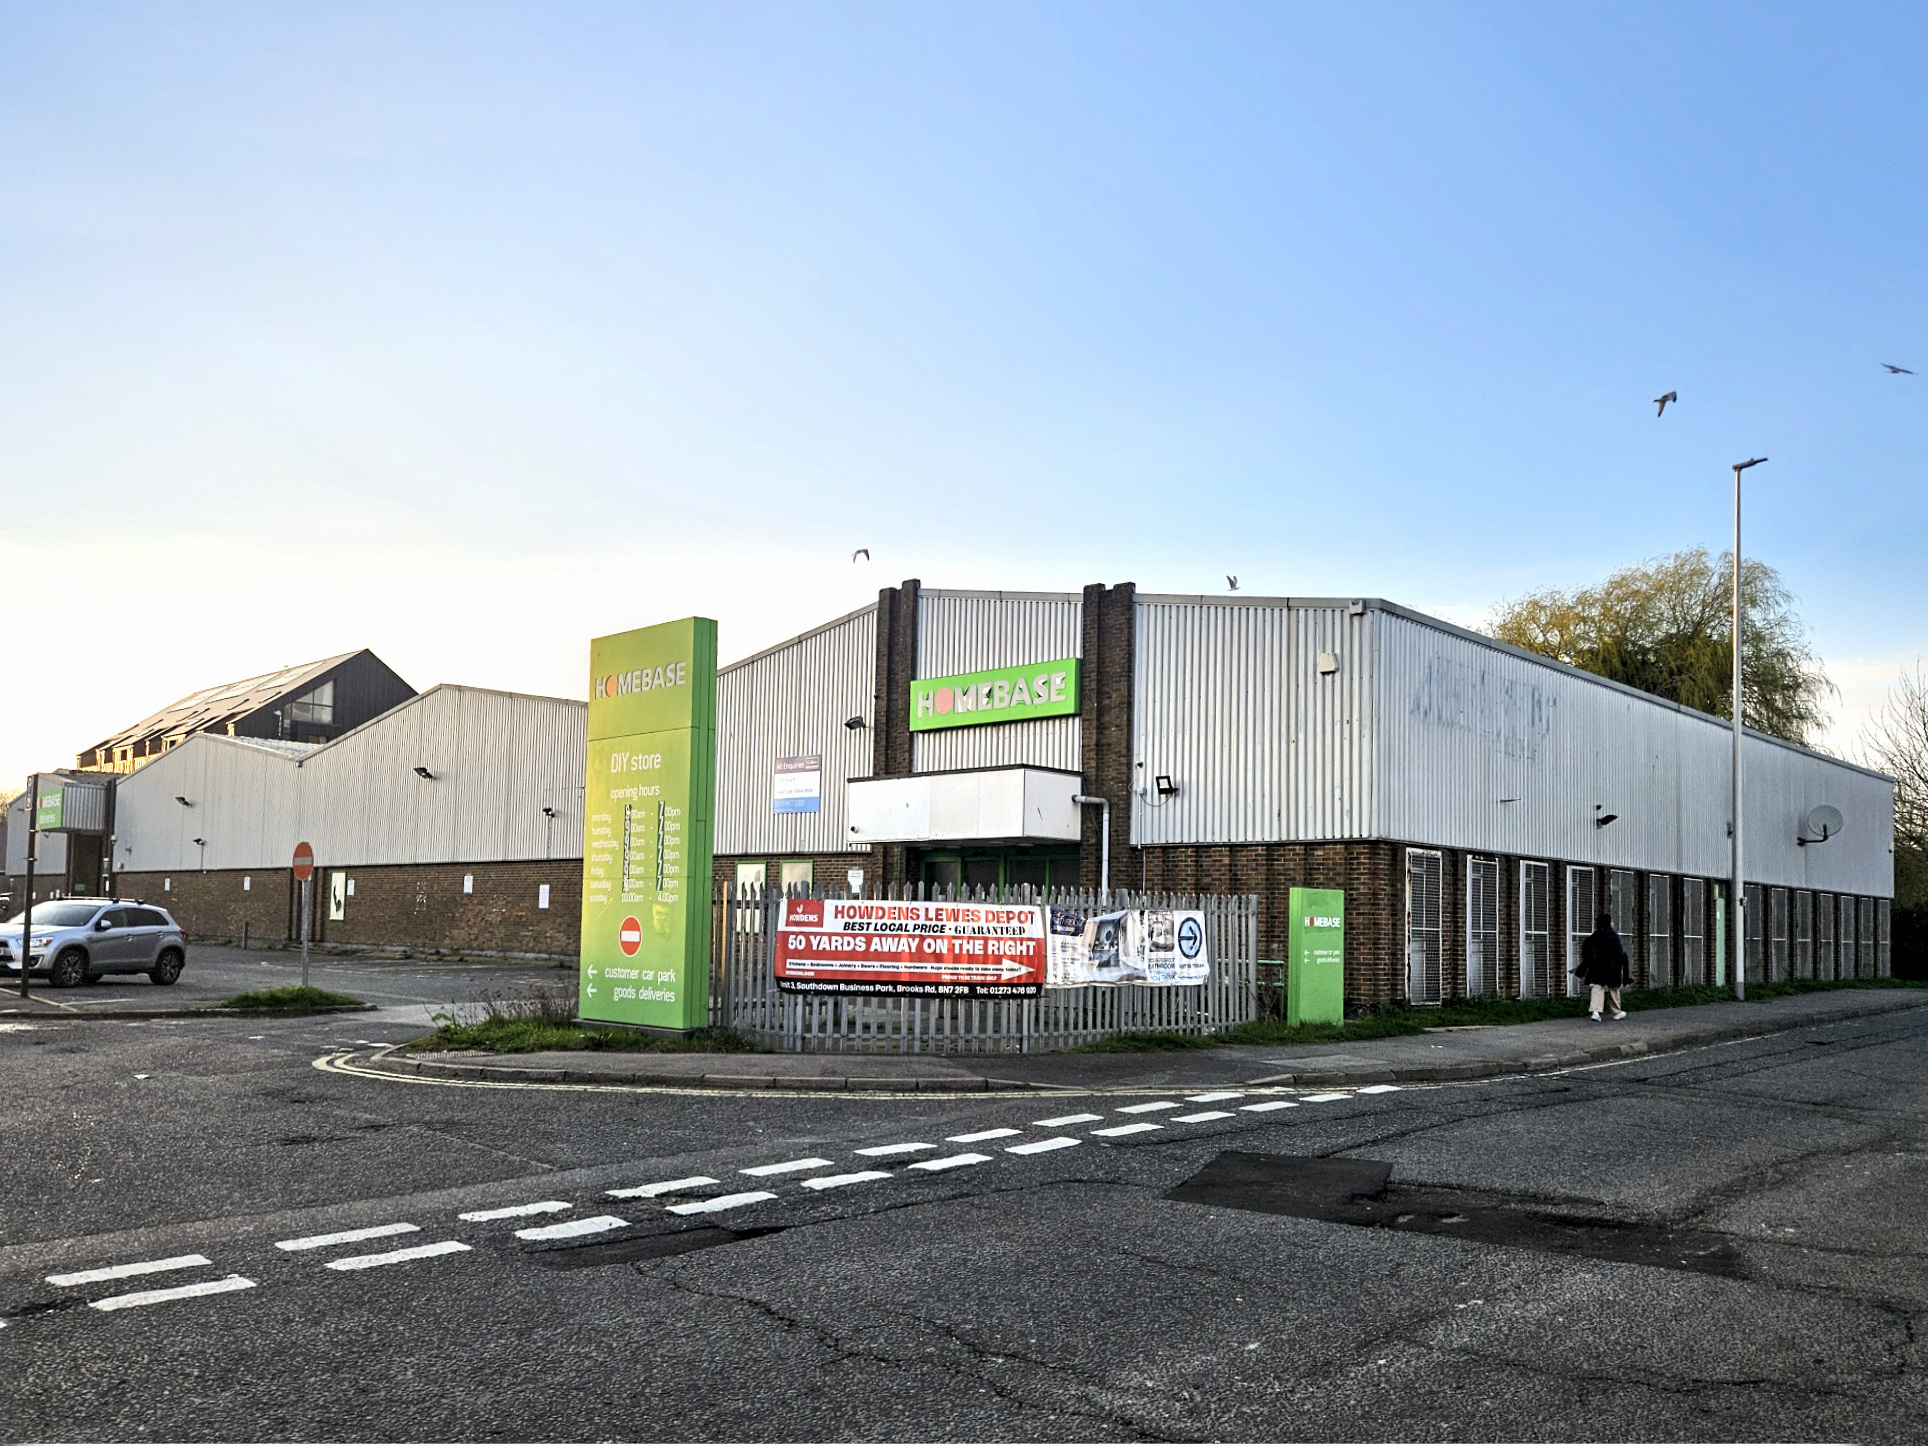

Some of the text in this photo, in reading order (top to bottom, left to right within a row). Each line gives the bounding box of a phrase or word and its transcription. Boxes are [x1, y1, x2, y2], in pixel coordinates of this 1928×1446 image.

[594, 661, 686, 700] HOMEBASE
[917, 671, 1067, 718] HOMEBASE
[611, 752, 662, 774] DIY store
[610, 784, 660, 803] opening hours
[834, 904, 920, 921] HOWDENS
[924, 907, 981, 923] LEWES
[985, 909, 1035, 925] DEPOT
[1304, 916, 1341, 927] HOMEBASE
[843, 922, 1026, 936] BEST LOCAL PRICE GUARANTEED
[788, 934, 1036, 956] 50 YARDS AWAY ON THE RIGHT
[605, 967, 676, 985] customer car park
[613, 985, 675, 1002] goods deliveries
[796, 982, 838, 991] Southdown
[840, 983, 874, 992] Business
[875, 984, 895, 993] Park,
[896, 984, 923, 993] Brooks
[938, 985, 953, 994] BN7
[954, 986, 969, 994] 2FB
[976, 986, 988, 994] Tel:
[989, 986, 1011, 995] 01273
